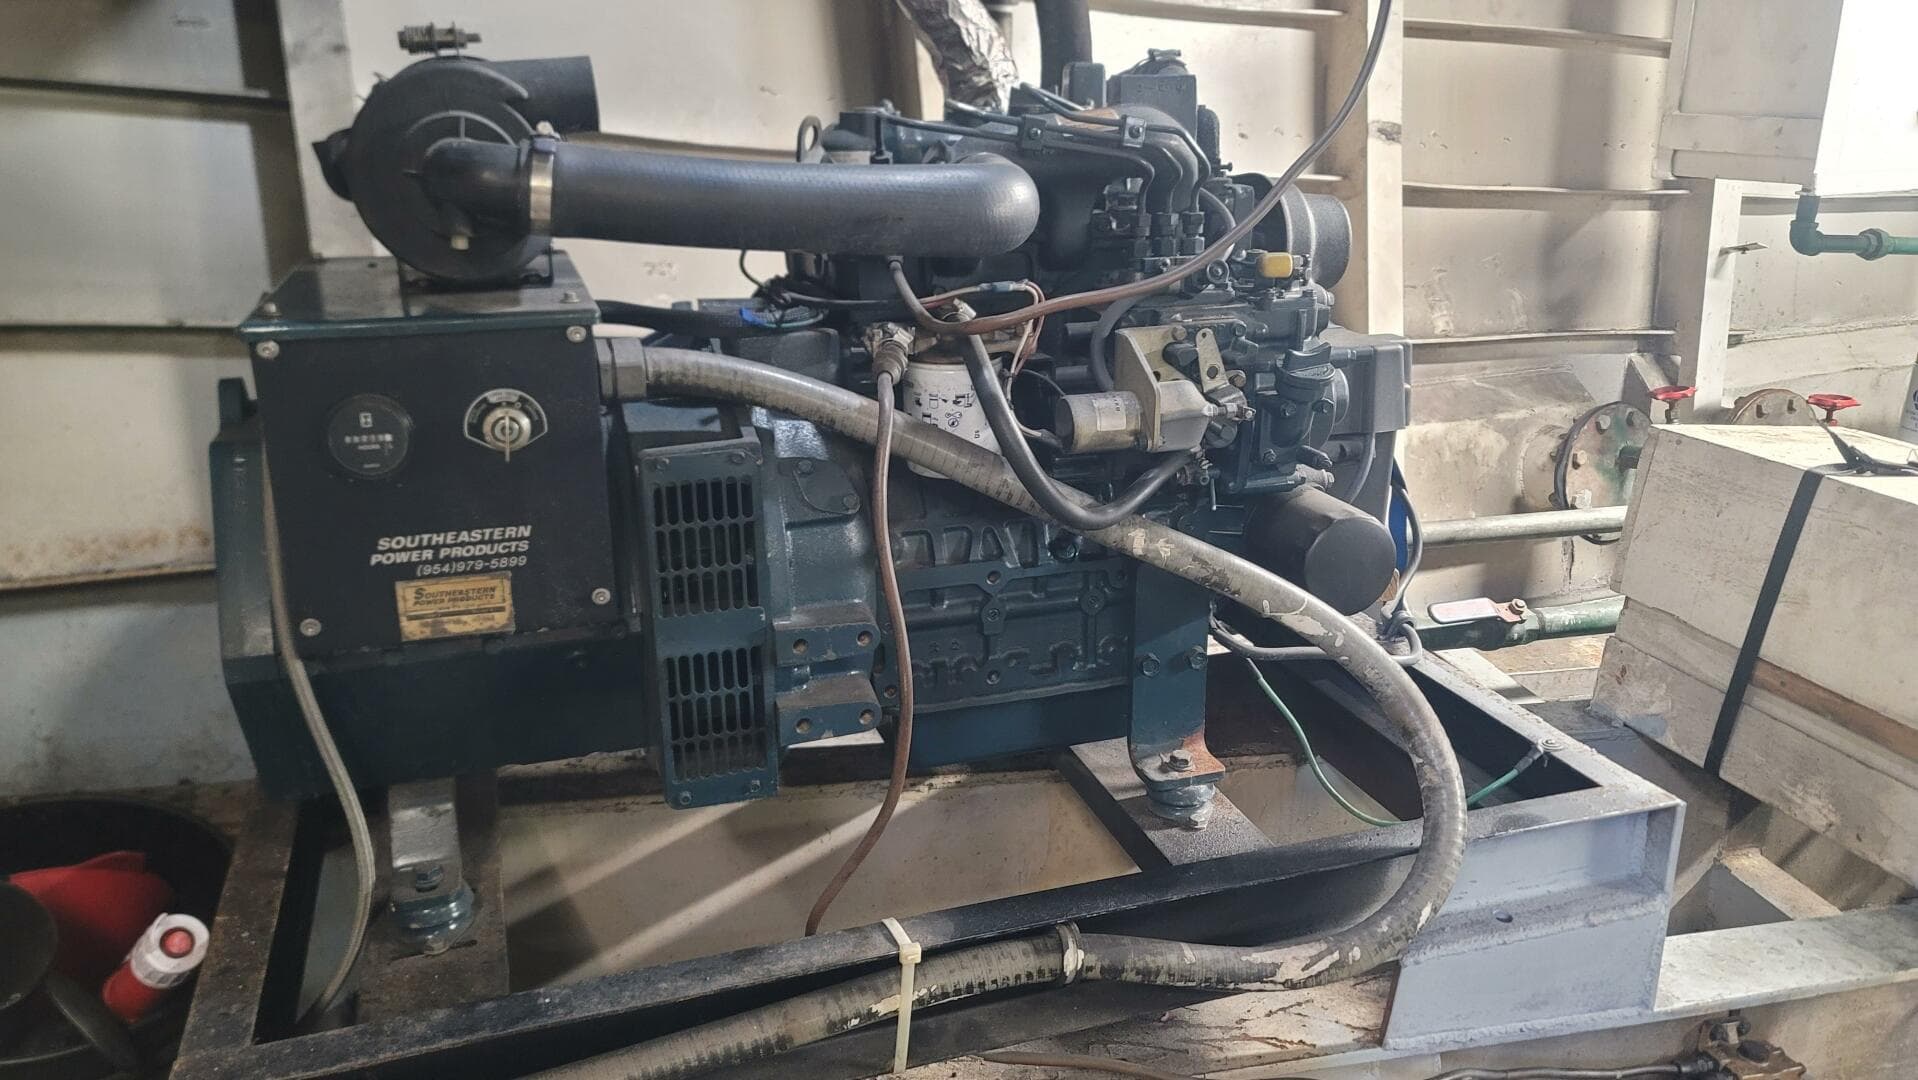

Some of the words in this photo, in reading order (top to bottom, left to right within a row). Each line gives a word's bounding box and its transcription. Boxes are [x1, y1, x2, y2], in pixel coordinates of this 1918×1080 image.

[377, 525, 532, 551] SOUTHEASTERN
[370, 549, 434, 566] POWER
[439, 540, 529, 559] PRODUCTS
[416, 555, 527, 577] (954)979-5899
